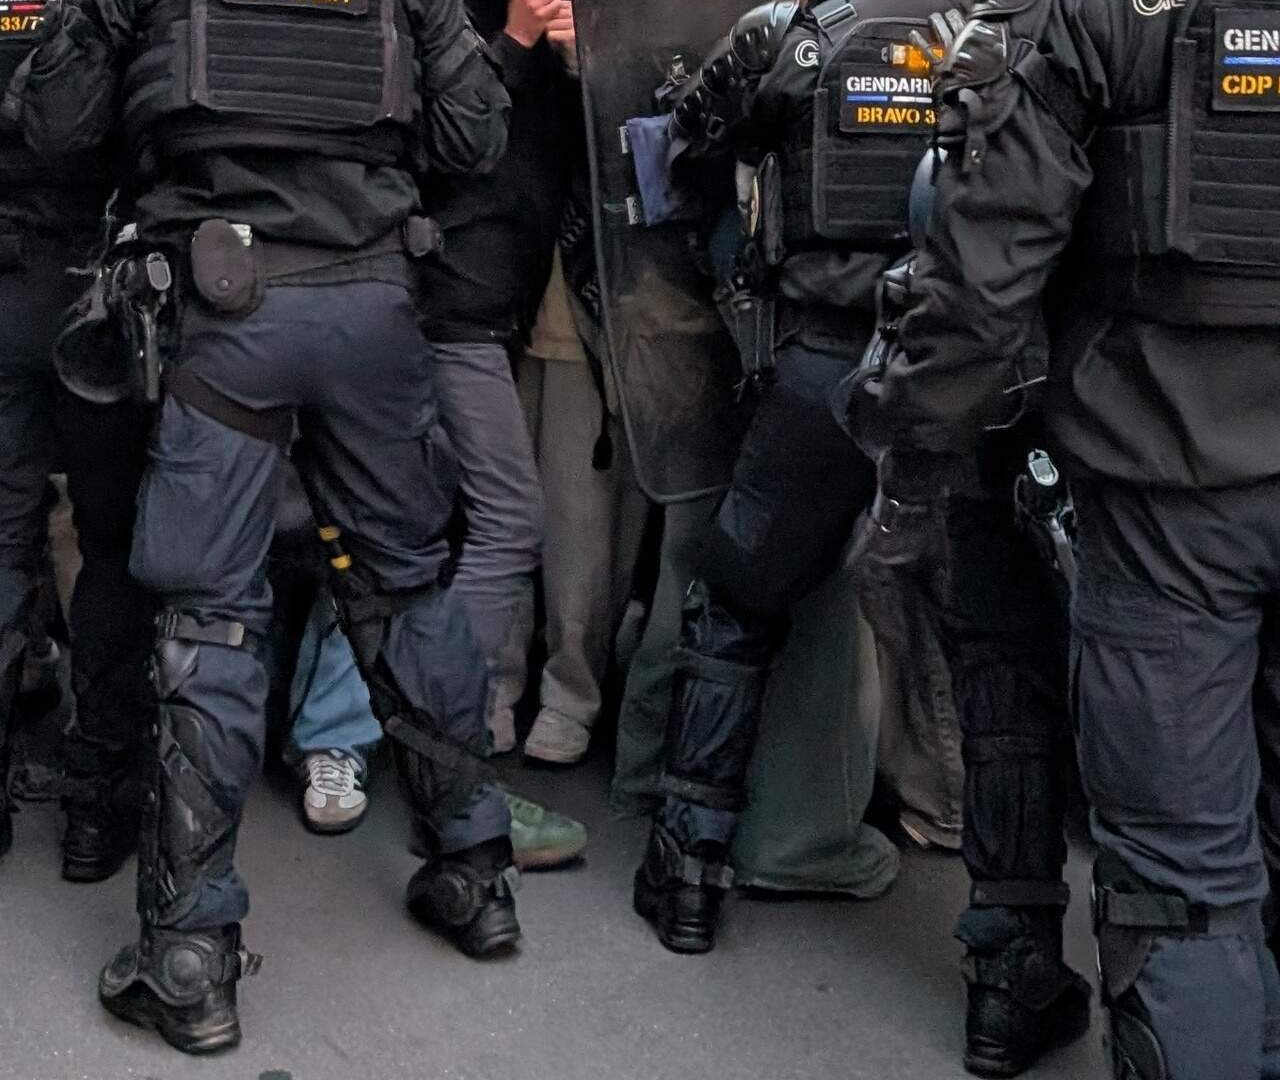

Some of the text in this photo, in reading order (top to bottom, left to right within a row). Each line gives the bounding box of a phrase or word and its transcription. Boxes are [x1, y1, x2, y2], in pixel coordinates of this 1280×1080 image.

[0, 15, 44, 32] 33/7
[1222, 75, 1273, 95] CDP
[857, 106, 921, 124] BRAVO
